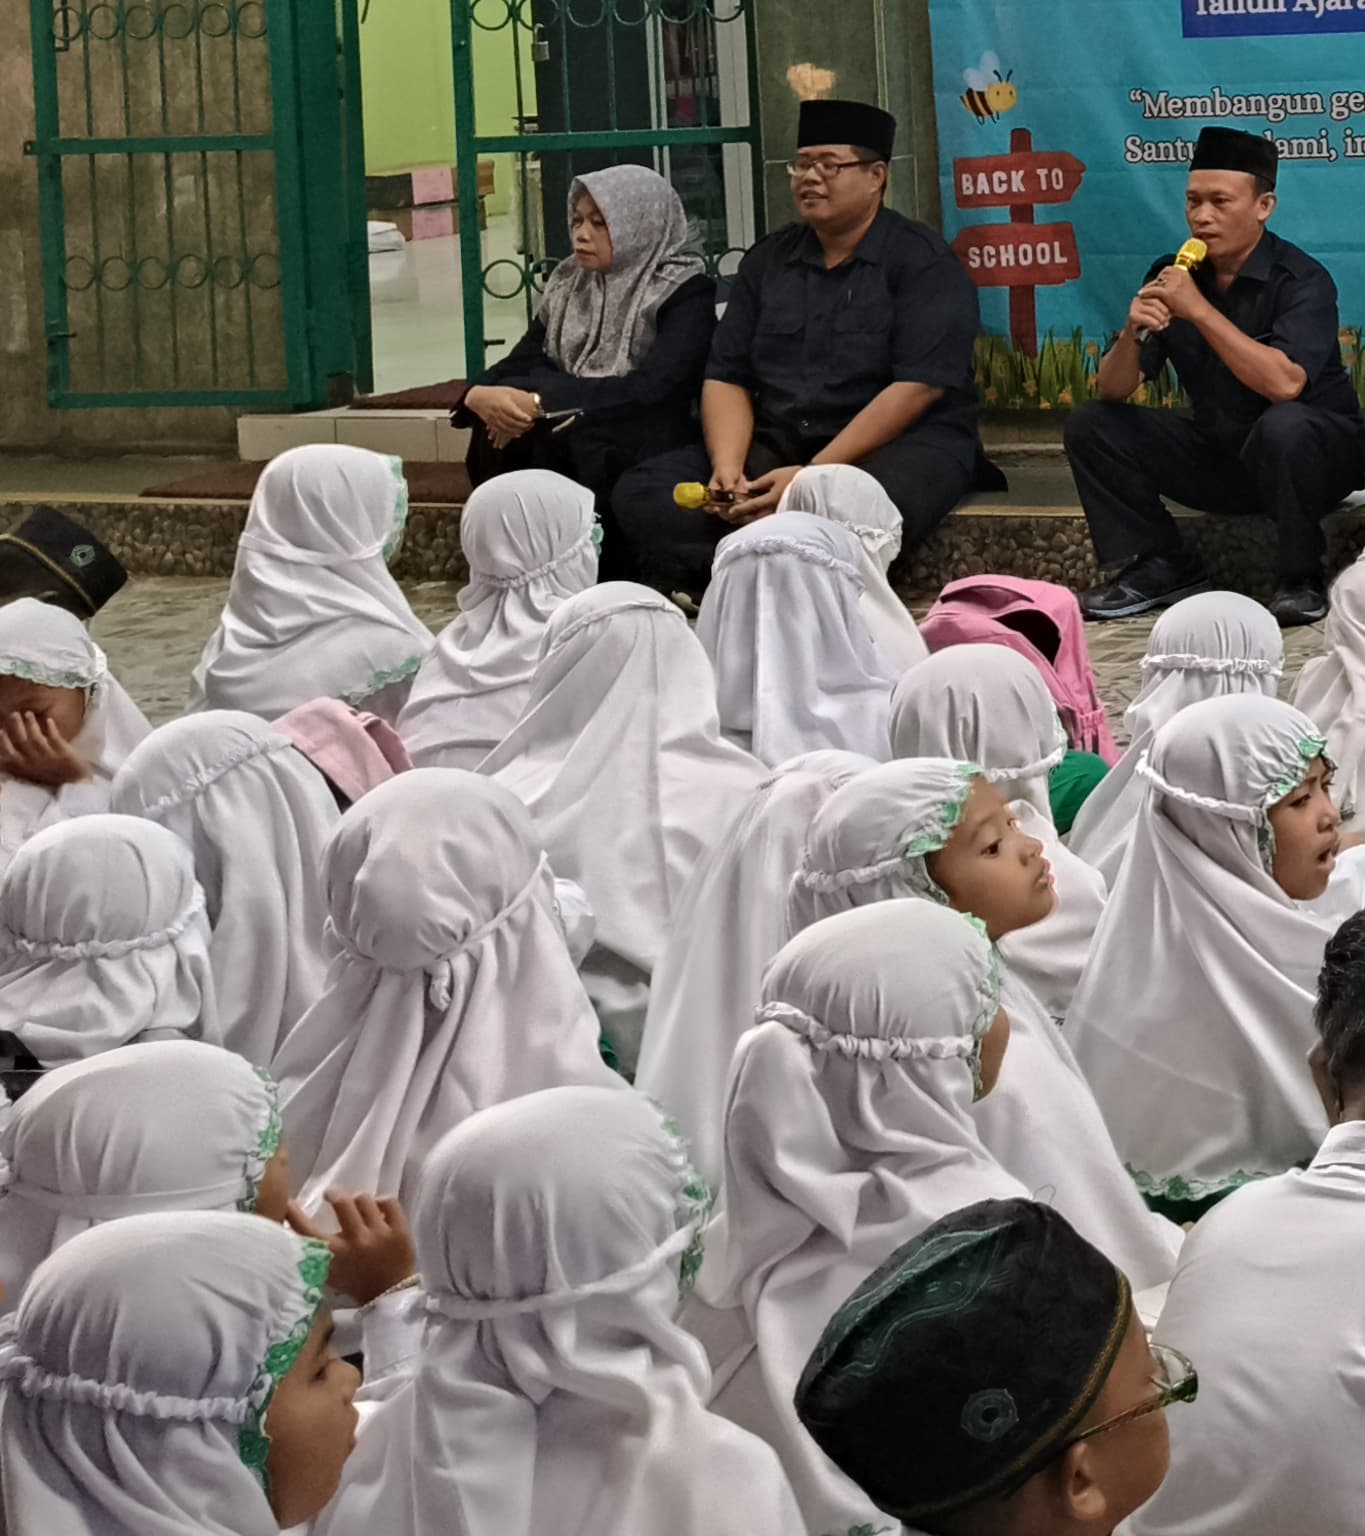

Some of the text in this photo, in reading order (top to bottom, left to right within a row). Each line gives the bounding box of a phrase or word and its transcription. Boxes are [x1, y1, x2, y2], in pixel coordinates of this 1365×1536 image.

[961, 167, 1064, 195] BACK TO
[967, 240, 1069, 268] SCHOOL
